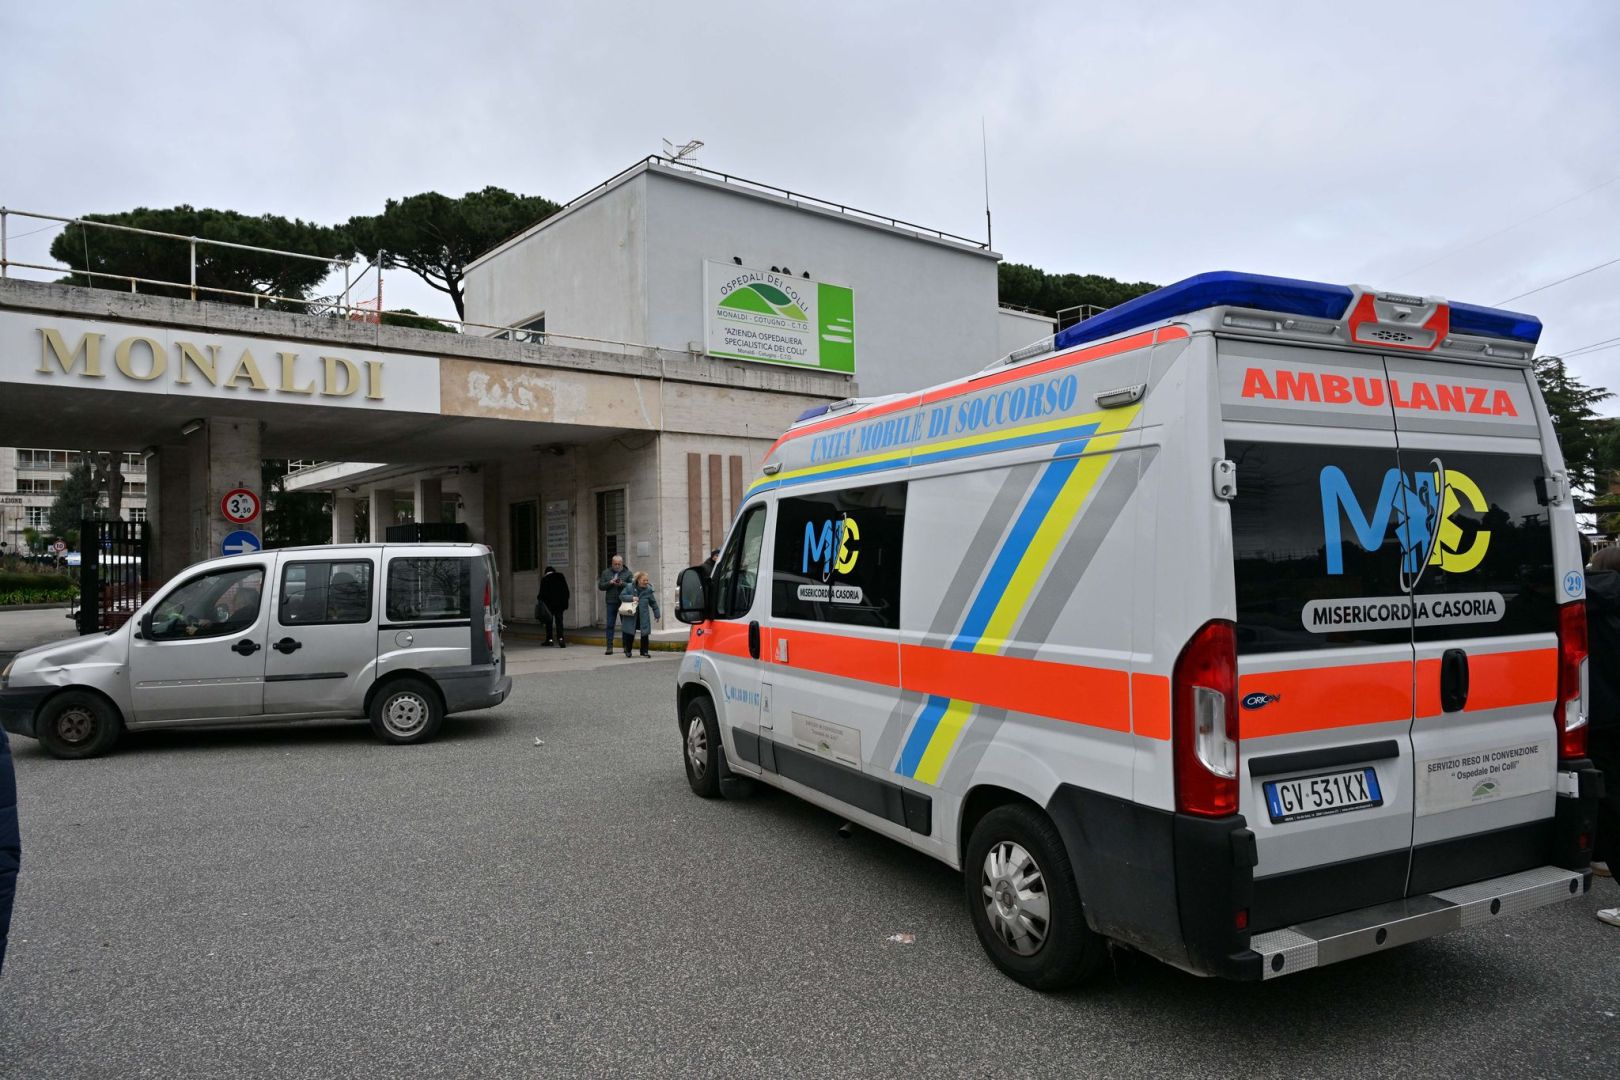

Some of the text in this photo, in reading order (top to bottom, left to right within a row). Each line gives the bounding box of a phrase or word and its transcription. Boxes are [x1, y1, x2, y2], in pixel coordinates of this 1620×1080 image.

[720, 273, 808, 312] OSPEDALI DEI COLLI
[716, 309, 748, 321] MONALDI
[753, 316, 786, 327] COTUGNO
[724, 337, 773, 351] SPECIALISTICA
[773, 344, 785, 353] DEI
[758, 332, 803, 345] OSPEDALIERA
[35, 327, 385, 401] MONALDI
[1241, 367, 1519, 417] AMBULANZA
[856, 411, 925, 454] MOBILE
[927, 403, 954, 440] DI
[955, 373, 1078, 434] SOCCORSO
[835, 589, 860, 600] CASORIA
[1567, 576, 1581, 591] 29
[1313, 598, 1497, 625] MISERICORDIA CASORIA
[1427, 745, 1539, 773] SERVIZIO RESO IN CONVENZIONE
[1457, 767, 1488, 780] Ospedale
[1490, 764, 1501, 774] Dei
[1280, 783, 1304, 812] GV
[1311, 773, 1369, 808] 531KX
